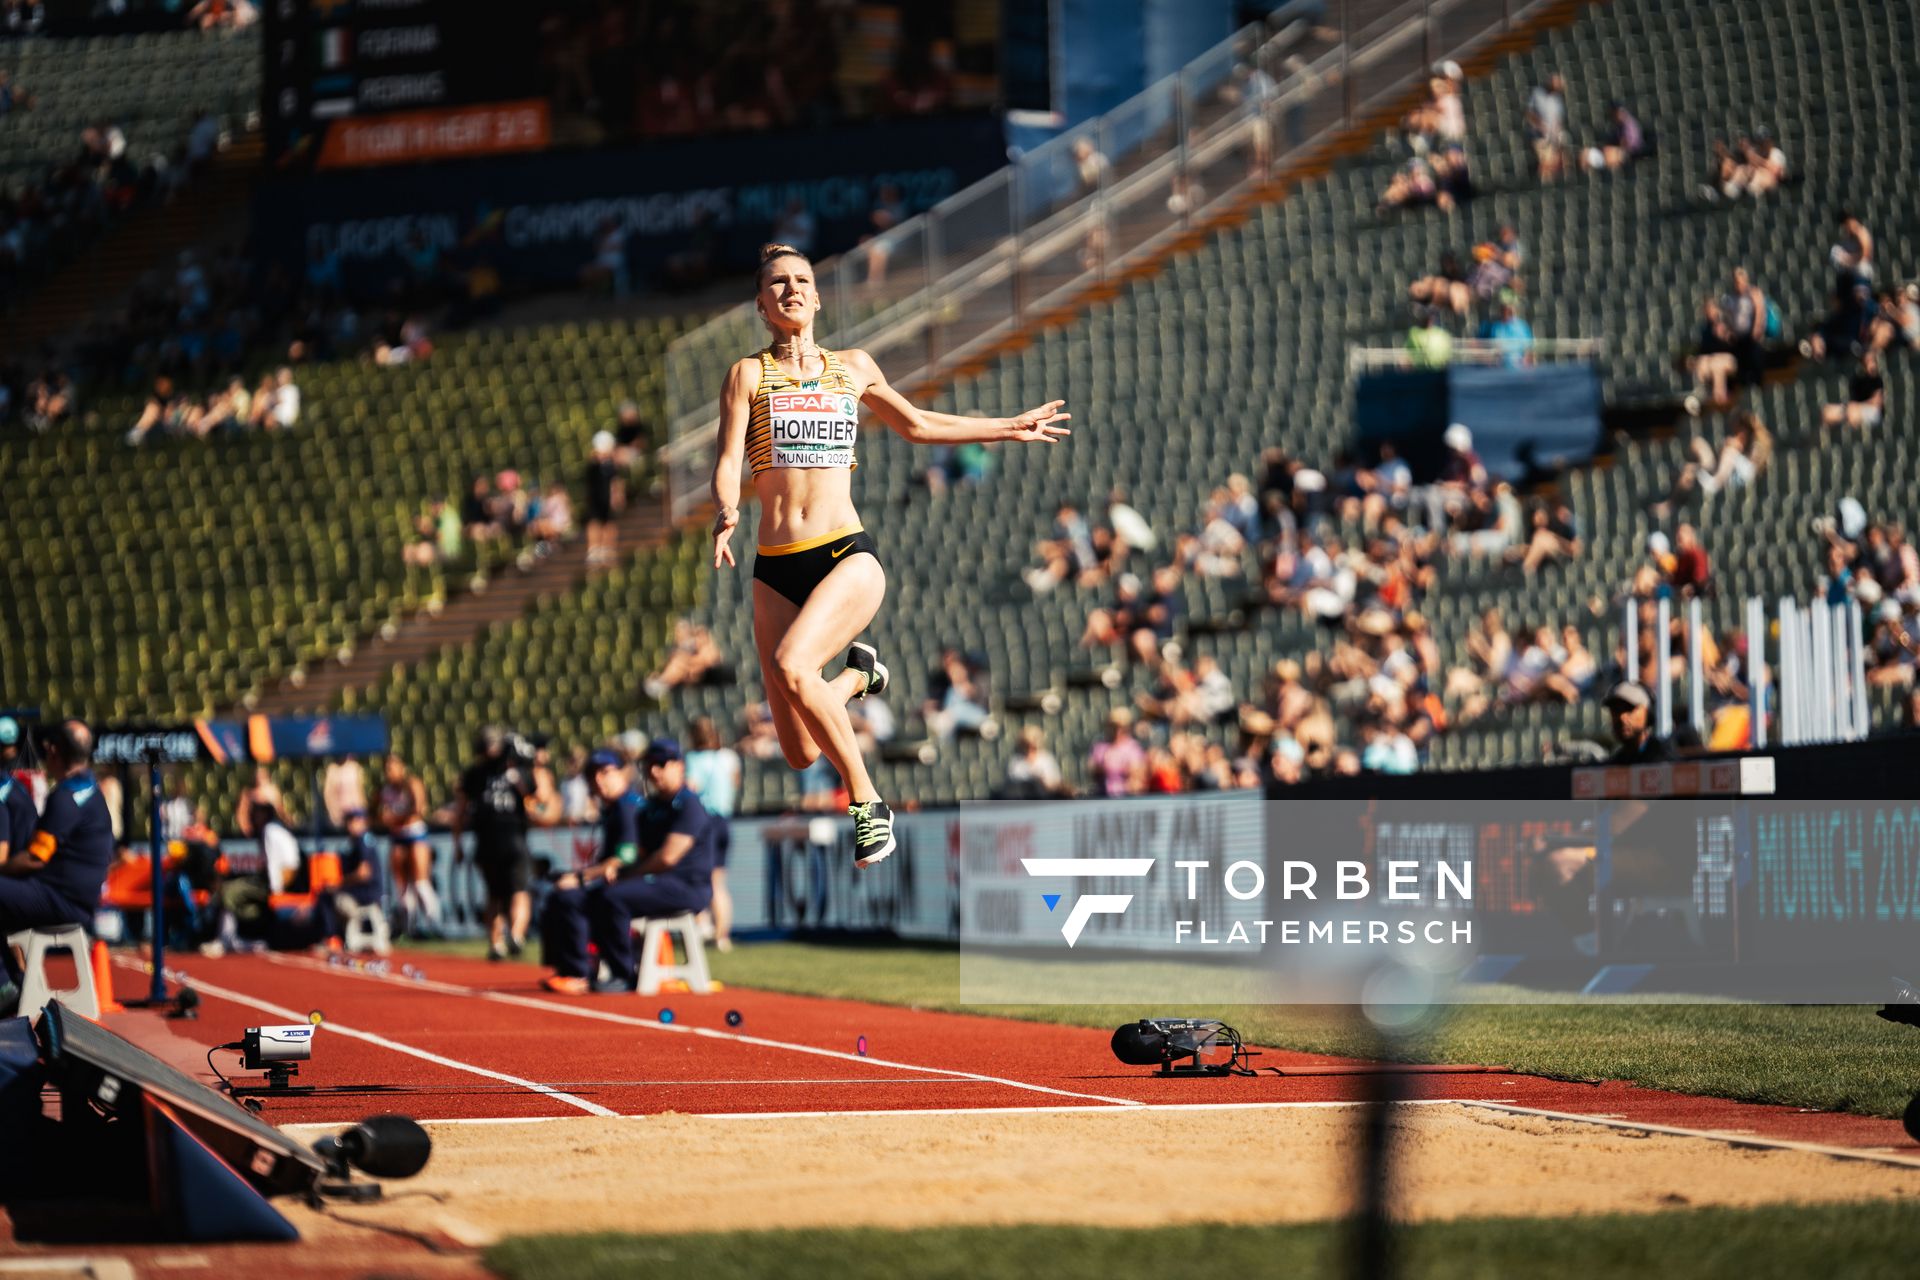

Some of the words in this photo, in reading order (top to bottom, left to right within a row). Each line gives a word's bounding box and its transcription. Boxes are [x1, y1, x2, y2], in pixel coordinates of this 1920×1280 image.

[504, 185, 734, 248] CHAMPIONSHIPS
[774, 395, 837, 411] SPAR
[774, 419, 854, 441] HOMEIER
[777, 453, 824, 464] MUNICH
[827, 453, 849, 465] 2022
[1756, 810, 1865, 922] MUNICH
